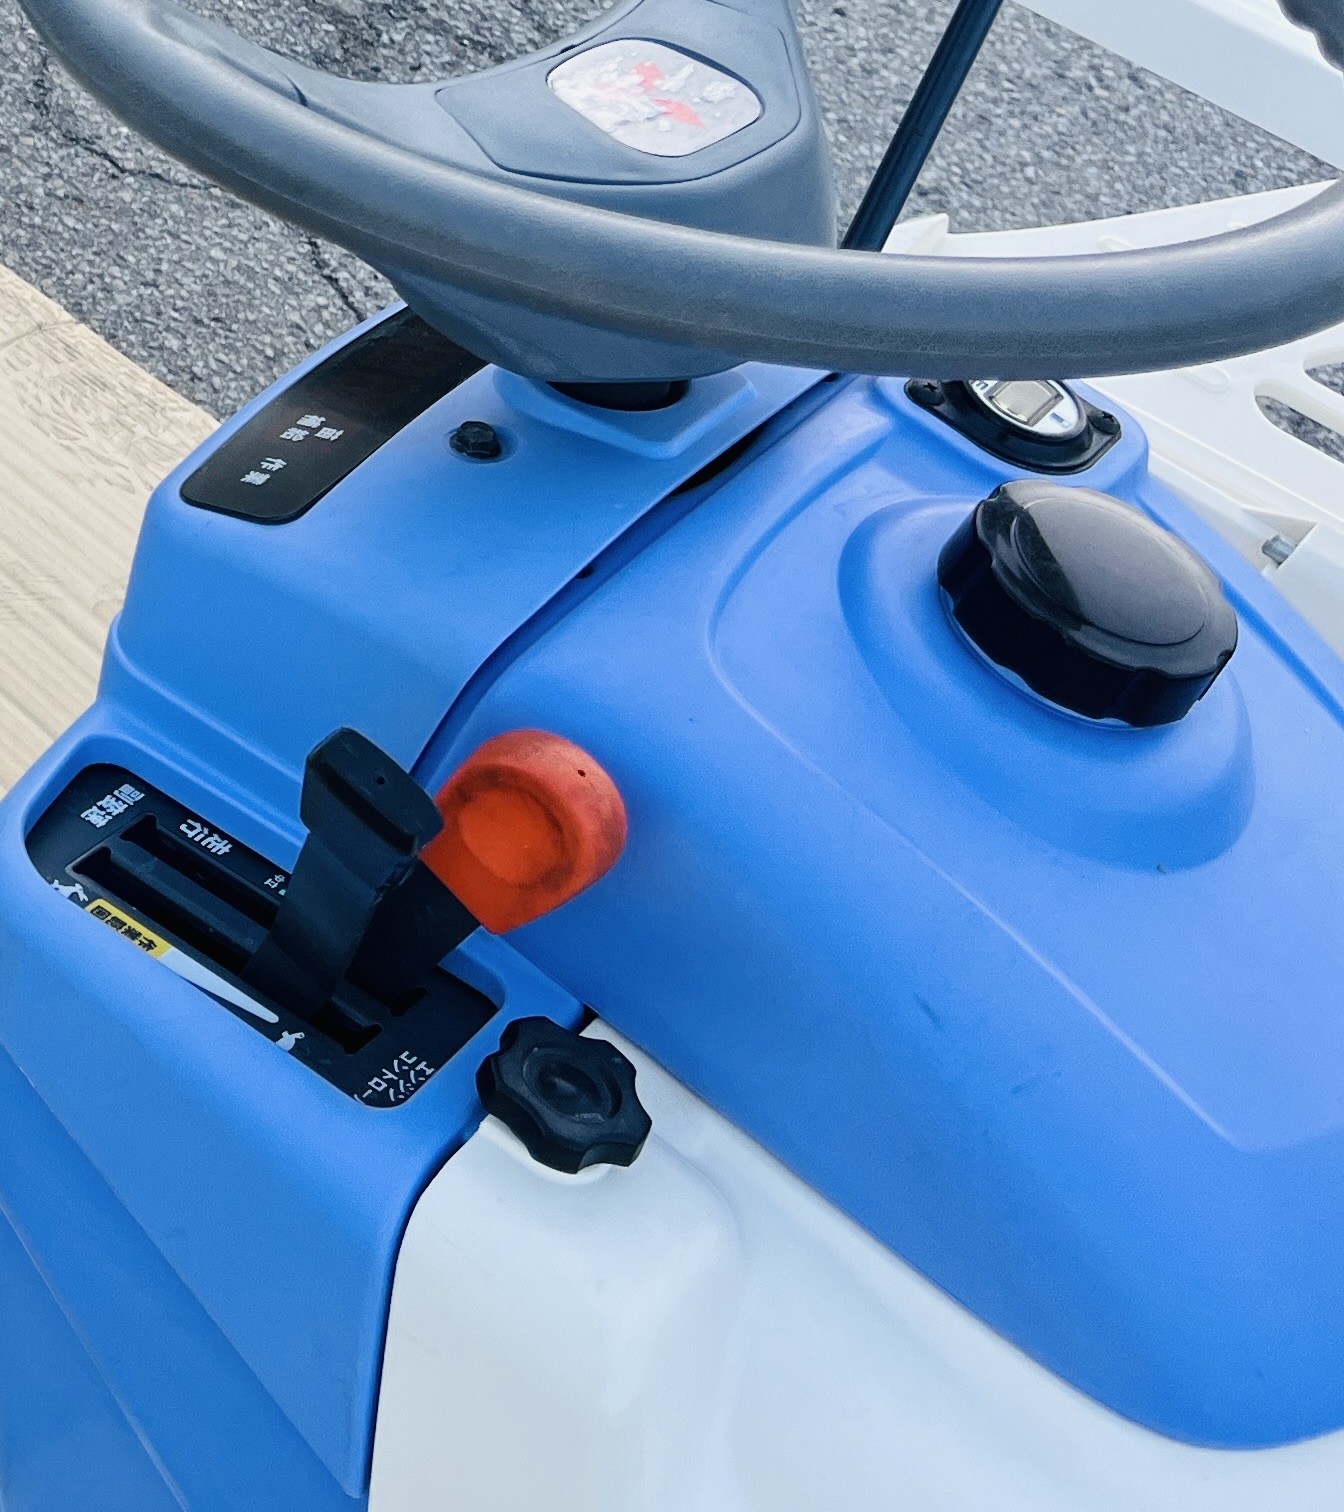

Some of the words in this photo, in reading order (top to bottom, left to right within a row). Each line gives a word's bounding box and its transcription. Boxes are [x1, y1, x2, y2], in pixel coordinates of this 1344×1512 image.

[239, 456, 288, 486] 作業
[80, 783, 145, 829] 副変速
[179, 818, 233, 856] 走行
[264, 874, 286, 889] 中立
[389, 1060, 435, 1102] エンジン
